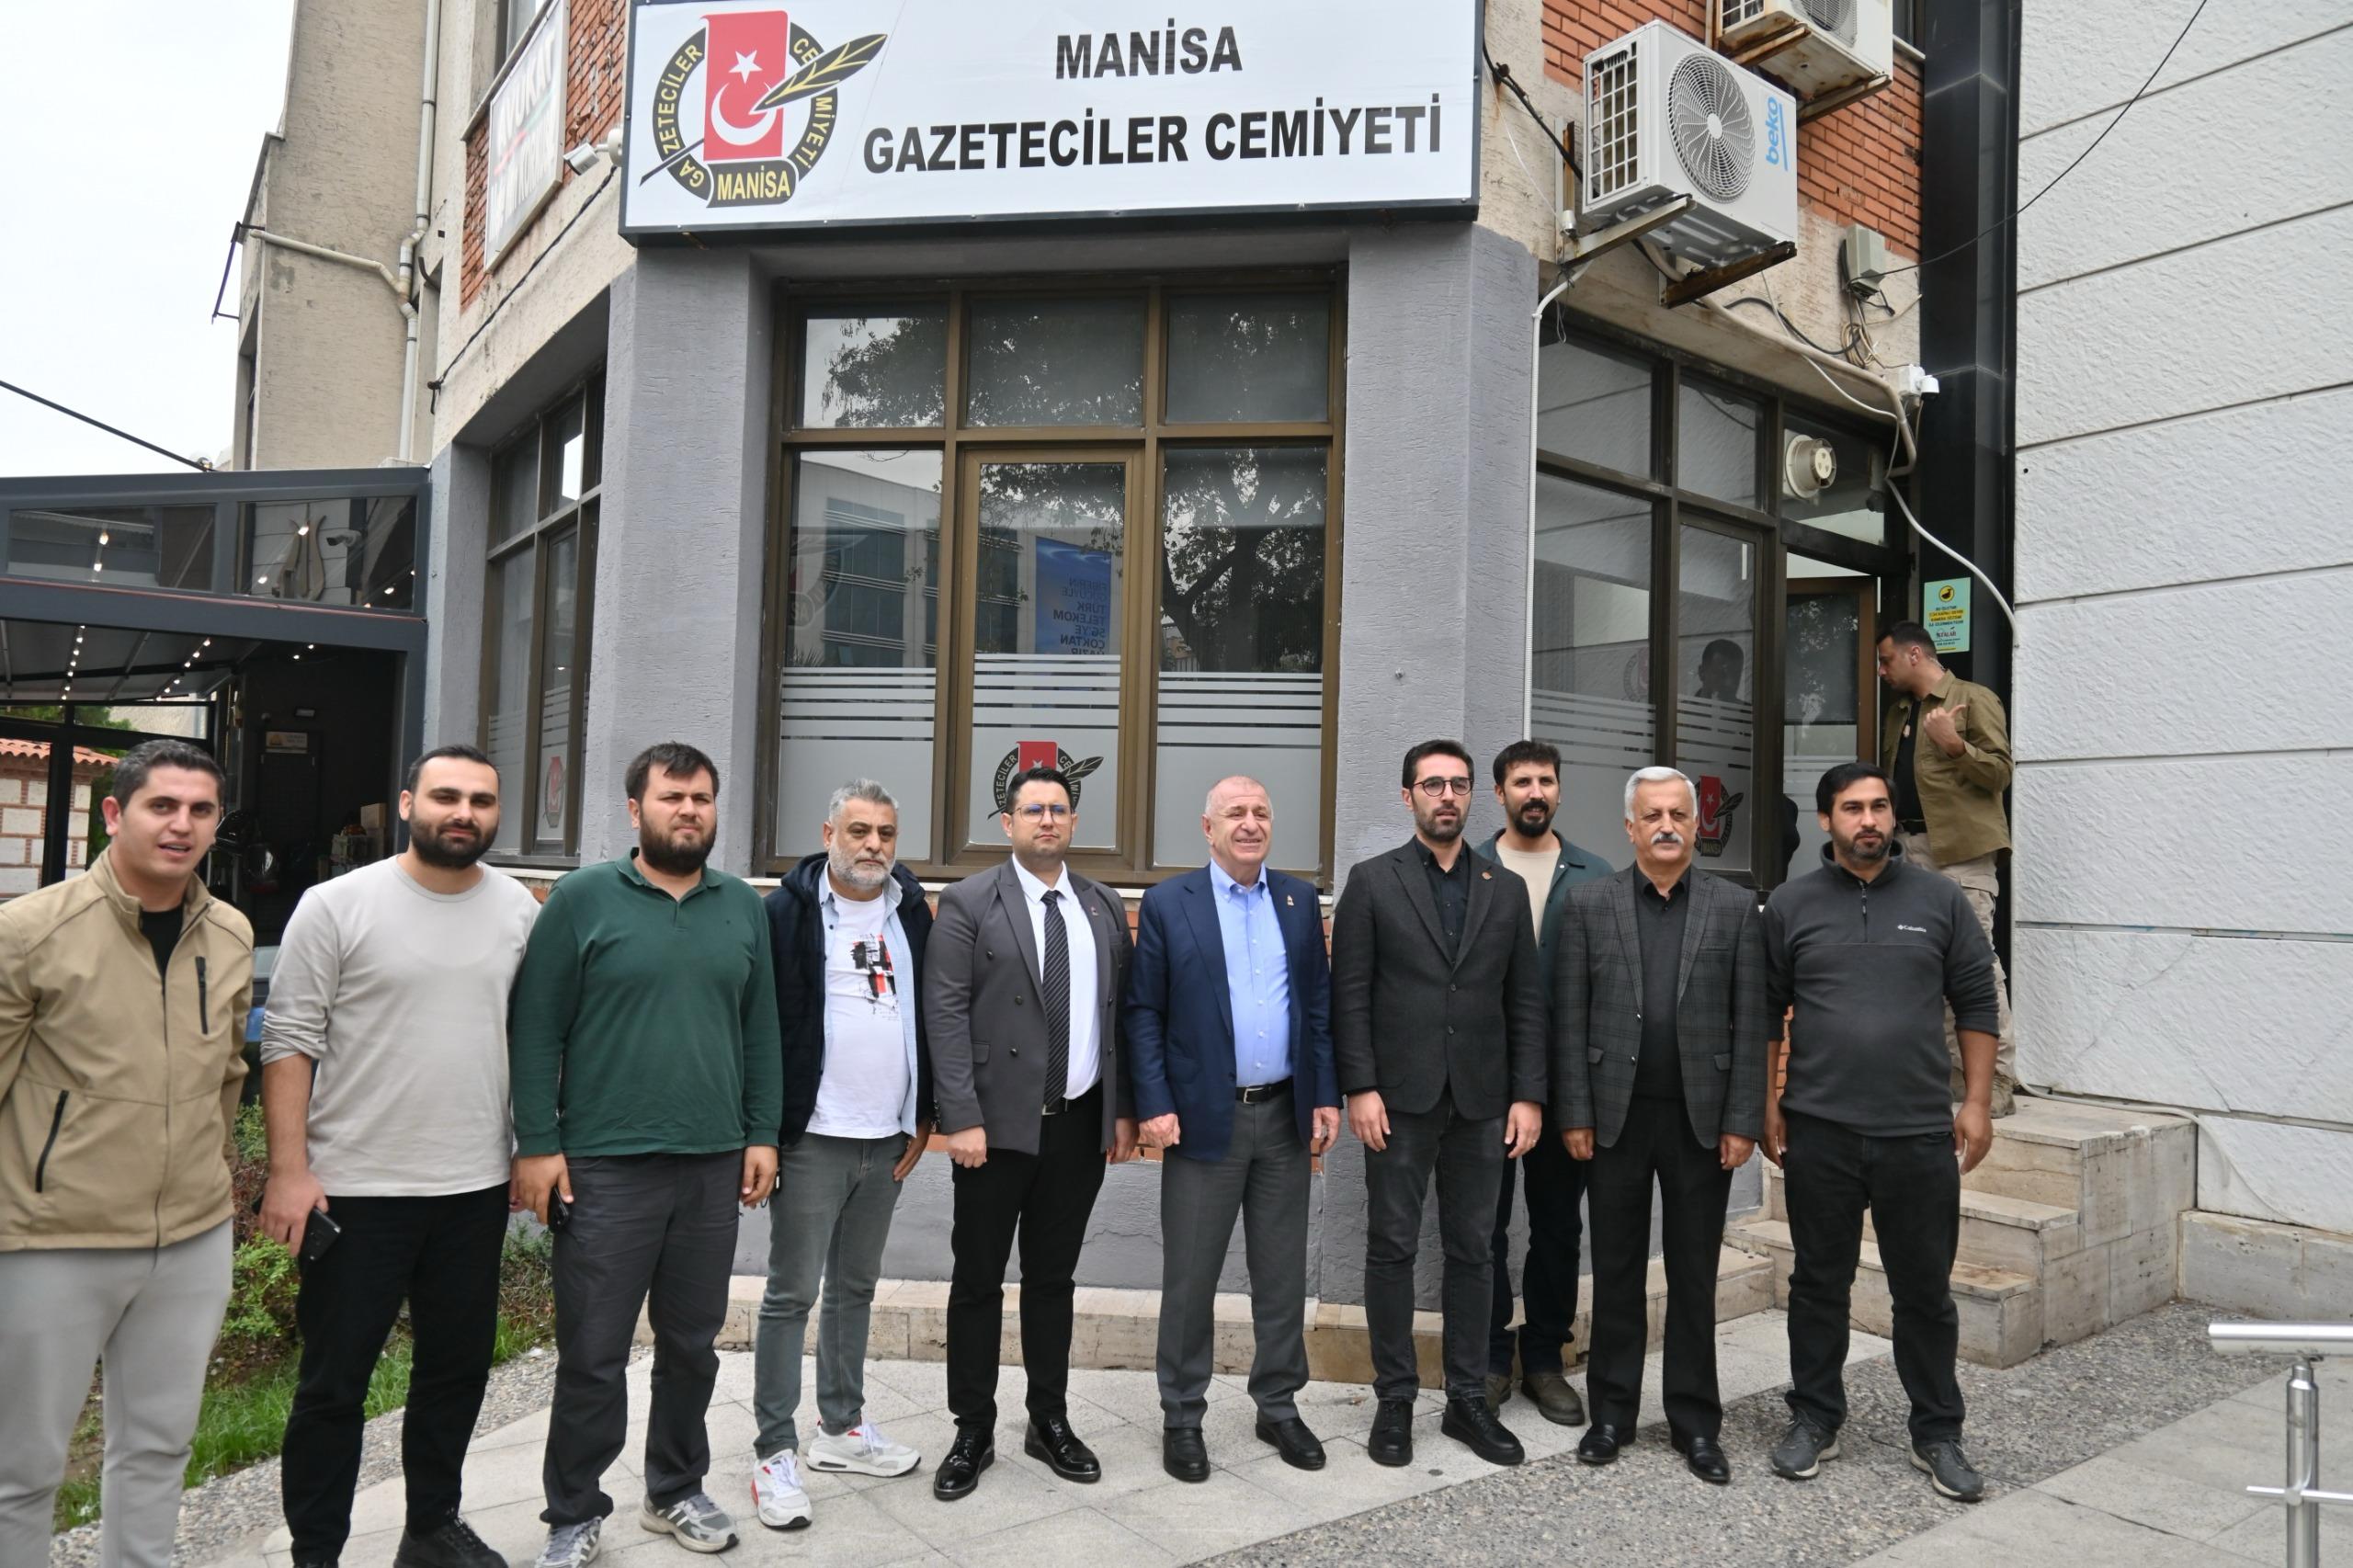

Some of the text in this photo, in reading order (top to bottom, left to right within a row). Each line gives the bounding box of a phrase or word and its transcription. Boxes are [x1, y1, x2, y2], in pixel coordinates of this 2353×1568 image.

[1056, 17, 1243, 79] MANİSA
[863, 93, 1440, 173] GAZETECİLER CEMİYETİ
[1766, 97, 1779, 165] beko
[717, 165, 791, 200] MANİSA
